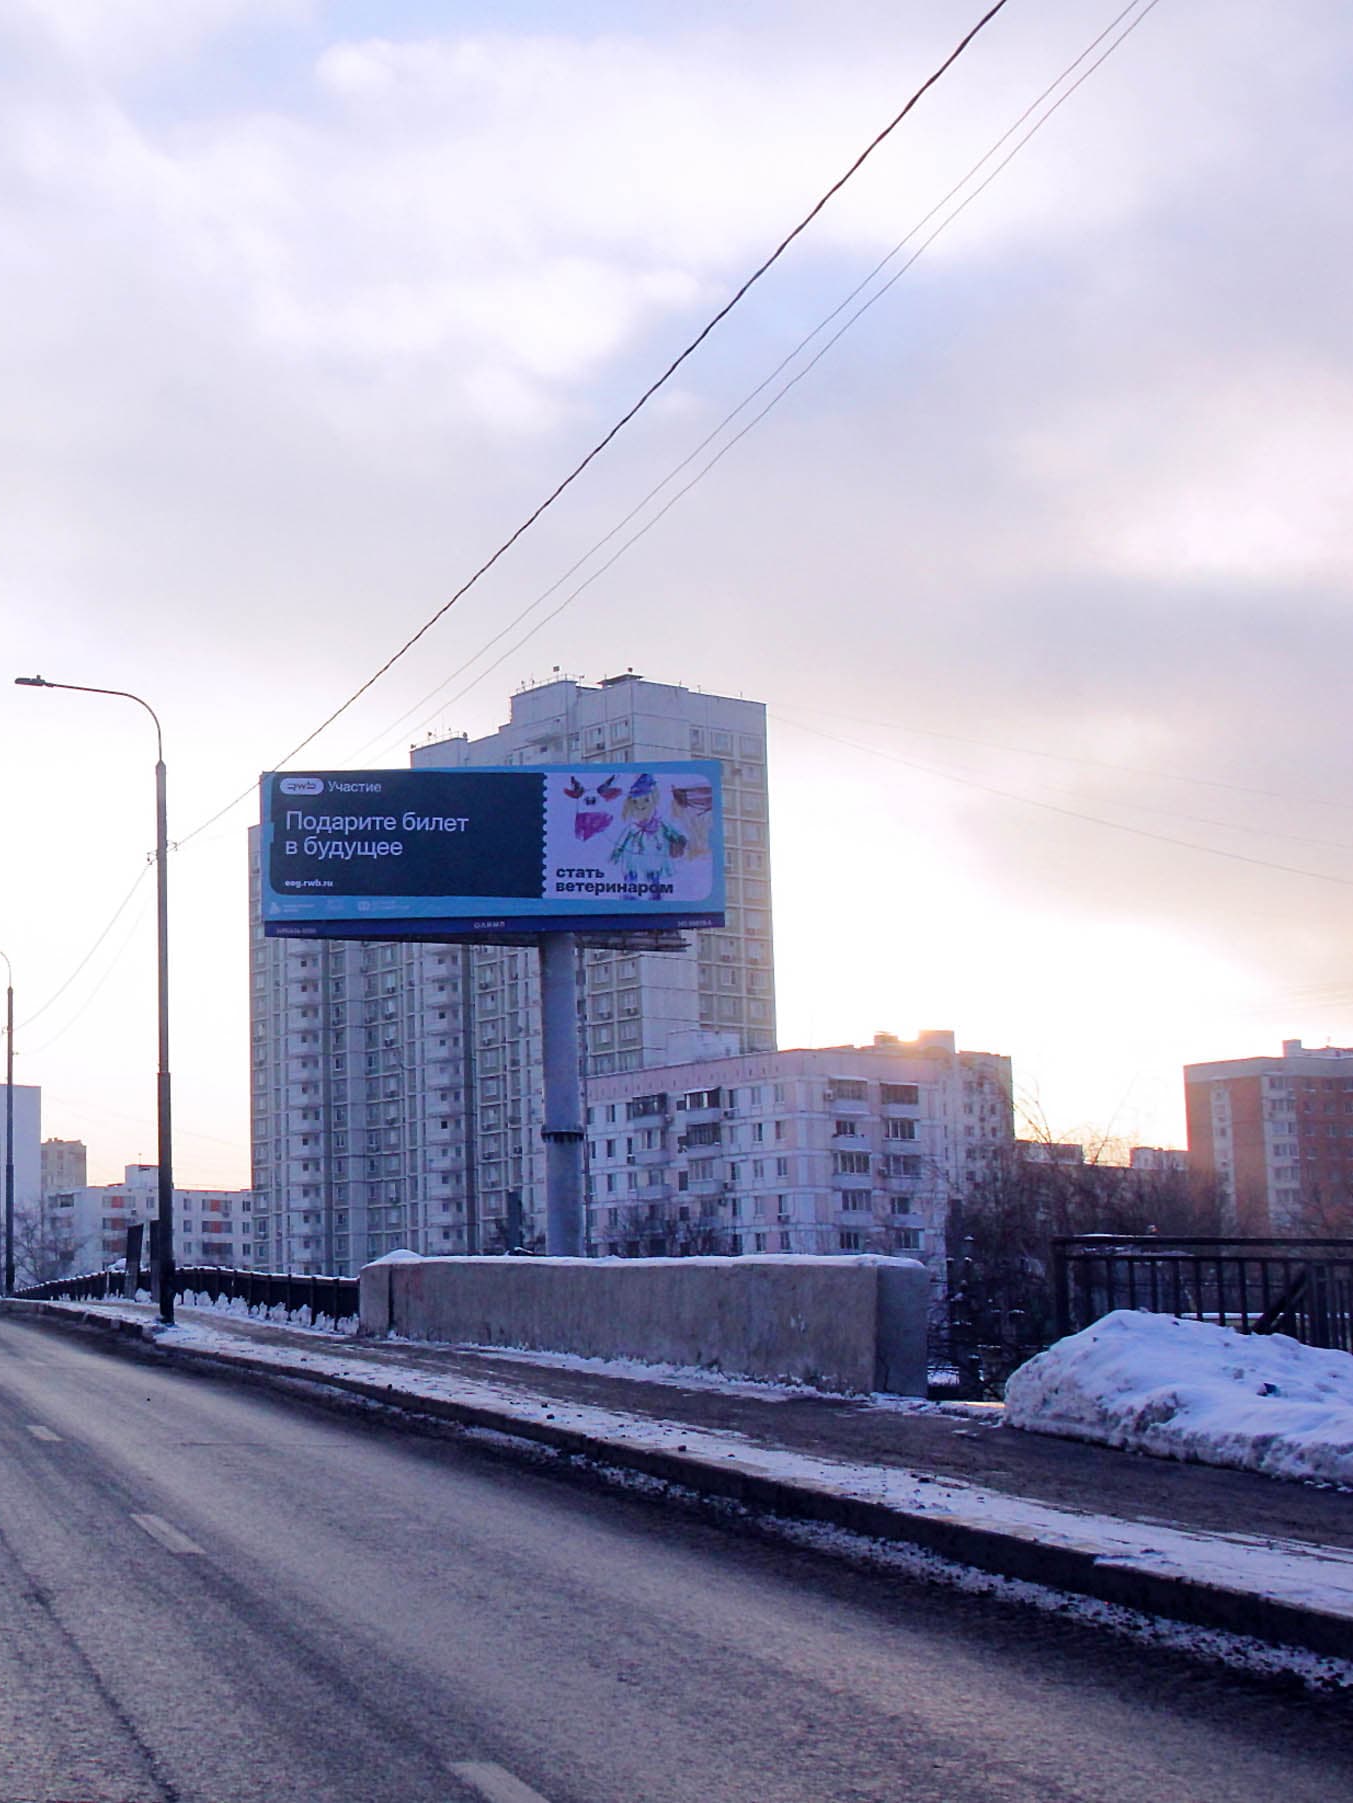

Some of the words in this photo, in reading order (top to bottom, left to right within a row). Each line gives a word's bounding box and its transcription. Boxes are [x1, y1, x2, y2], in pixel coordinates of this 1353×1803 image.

[327, 780, 382, 793] Участие
[285, 811, 397, 835] Подарите
[402, 811, 470, 832] билет
[285, 840, 298, 855] в
[303, 836, 404, 860] будущее
[555, 867, 605, 879] стать
[555, 880, 674, 897] ветеринаром
